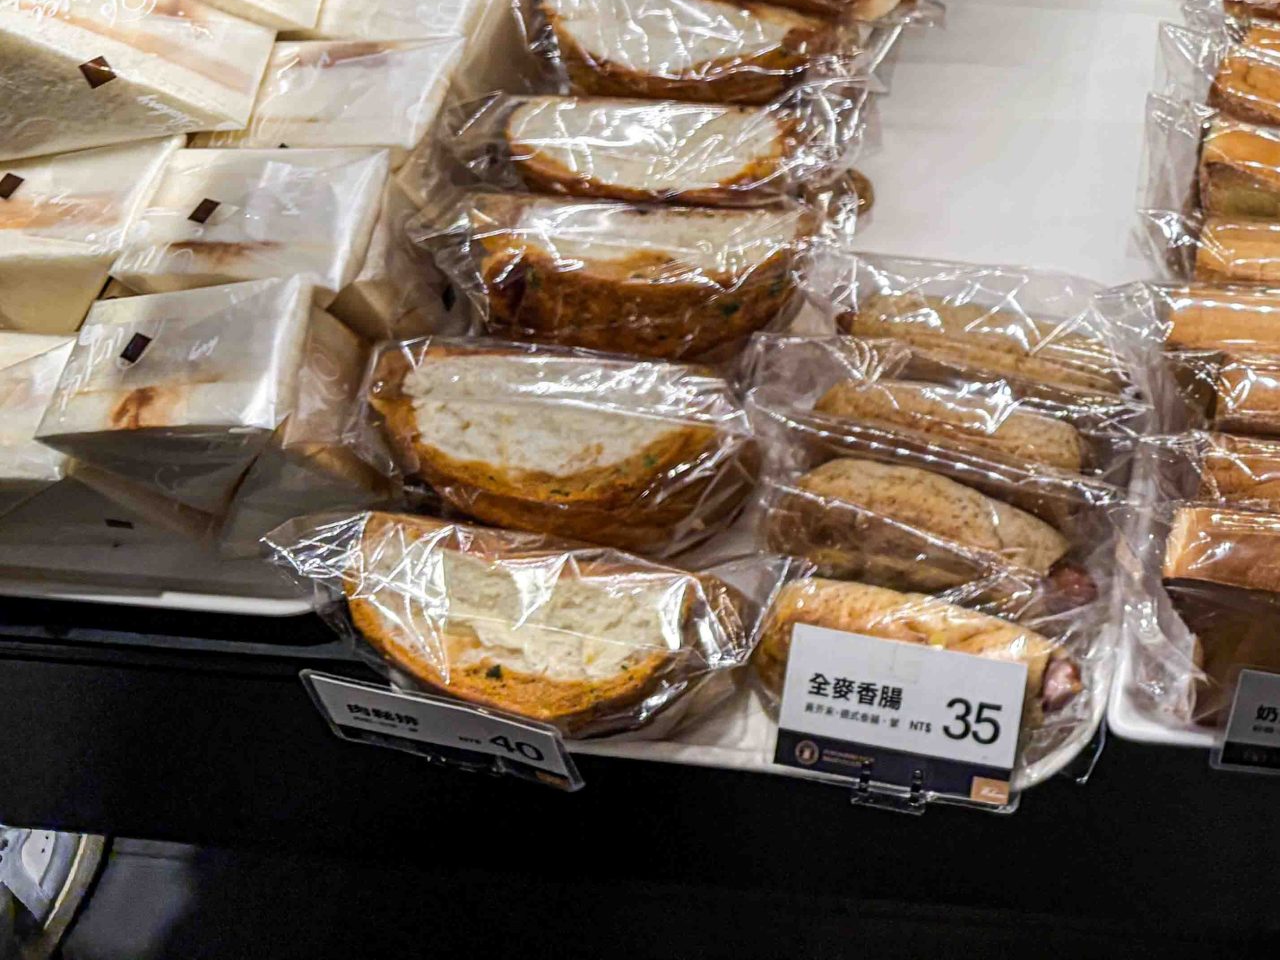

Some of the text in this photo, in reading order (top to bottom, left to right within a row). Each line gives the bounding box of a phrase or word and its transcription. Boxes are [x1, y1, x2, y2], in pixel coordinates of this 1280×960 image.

[808, 672, 903, 710] 全麥香腸
[942, 697, 1003, 745] 35
[489, 735, 545, 761] 40
